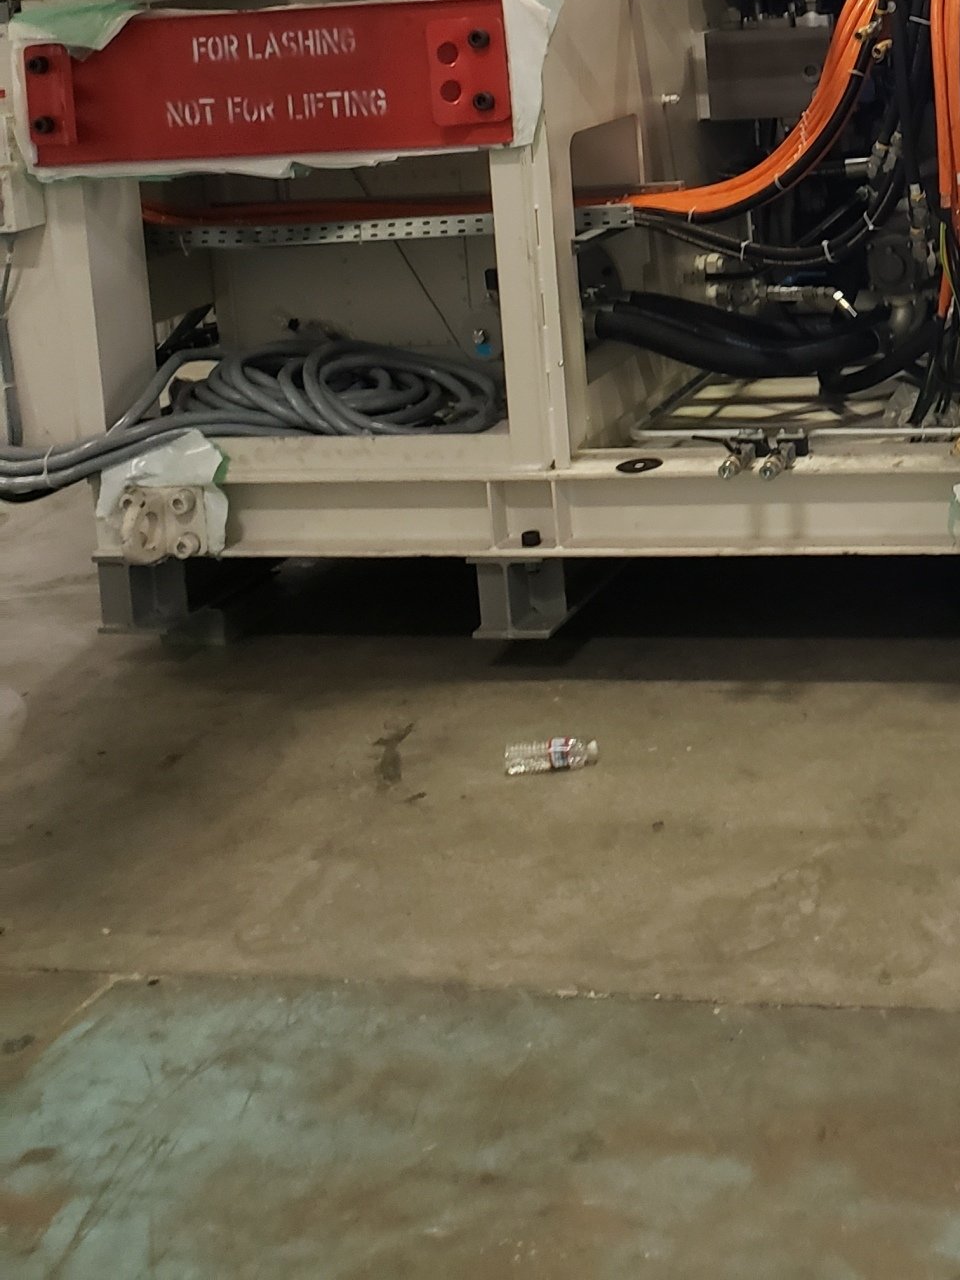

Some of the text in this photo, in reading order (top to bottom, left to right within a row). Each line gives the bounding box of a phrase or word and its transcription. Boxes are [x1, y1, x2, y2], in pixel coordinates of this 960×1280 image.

[192, 27, 356, 63] FOR LASHING
[166, 88, 388, 128] NOT FOR LIFTING
